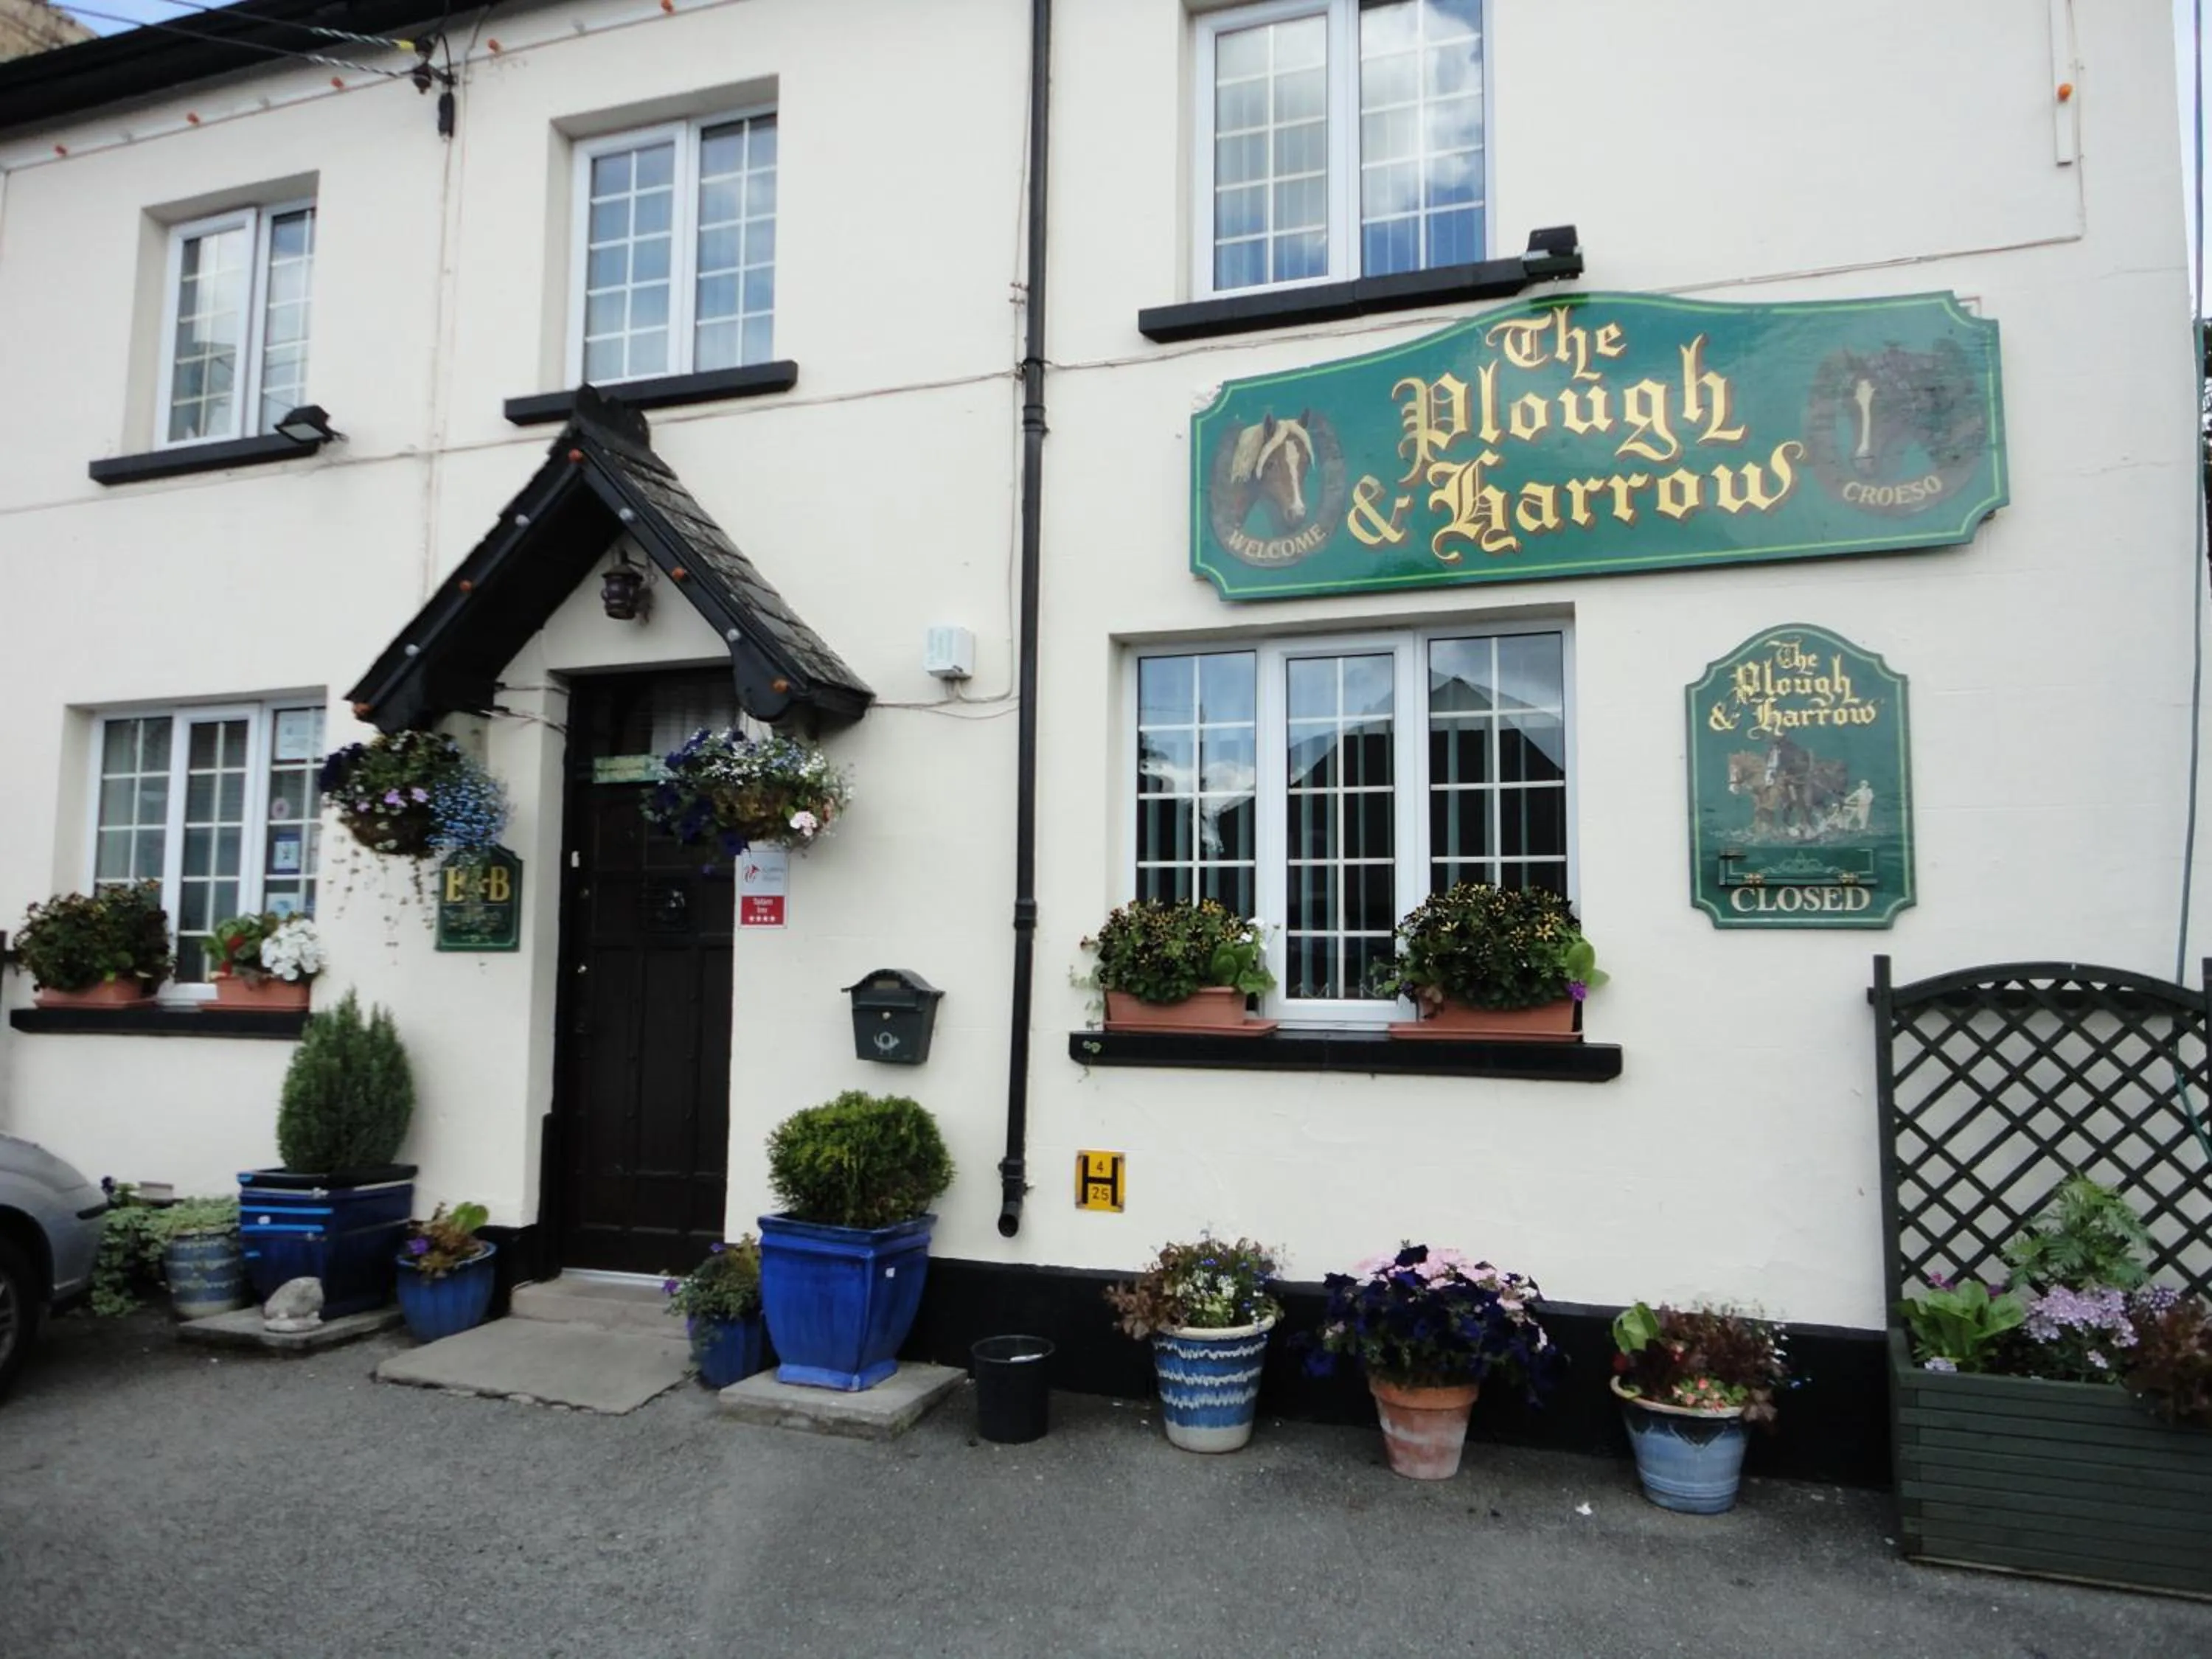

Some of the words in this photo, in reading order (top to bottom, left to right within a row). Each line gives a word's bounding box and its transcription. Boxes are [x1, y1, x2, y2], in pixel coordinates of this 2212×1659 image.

[1485, 306, 1627, 381] The
[1391, 333, 1746, 484] Plough
[1347, 475, 1411, 546] &
[1427, 439, 1805, 561] Harrow
[1843, 476, 1942, 506] CROESO
[1228, 523, 1326, 559] WELCOME
[1764, 636, 1818, 675] The
[1725, 654, 1860, 712] Plough
[1708, 701, 1741, 731] &
[1747, 698, 1877, 740] Harrow
[1731, 887, 1871, 913] CLOSED
[1082, 1155, 1118, 1206] H
[1096, 1160, 1105, 1174] 4
[1091, 1186, 1110, 1202] 25
